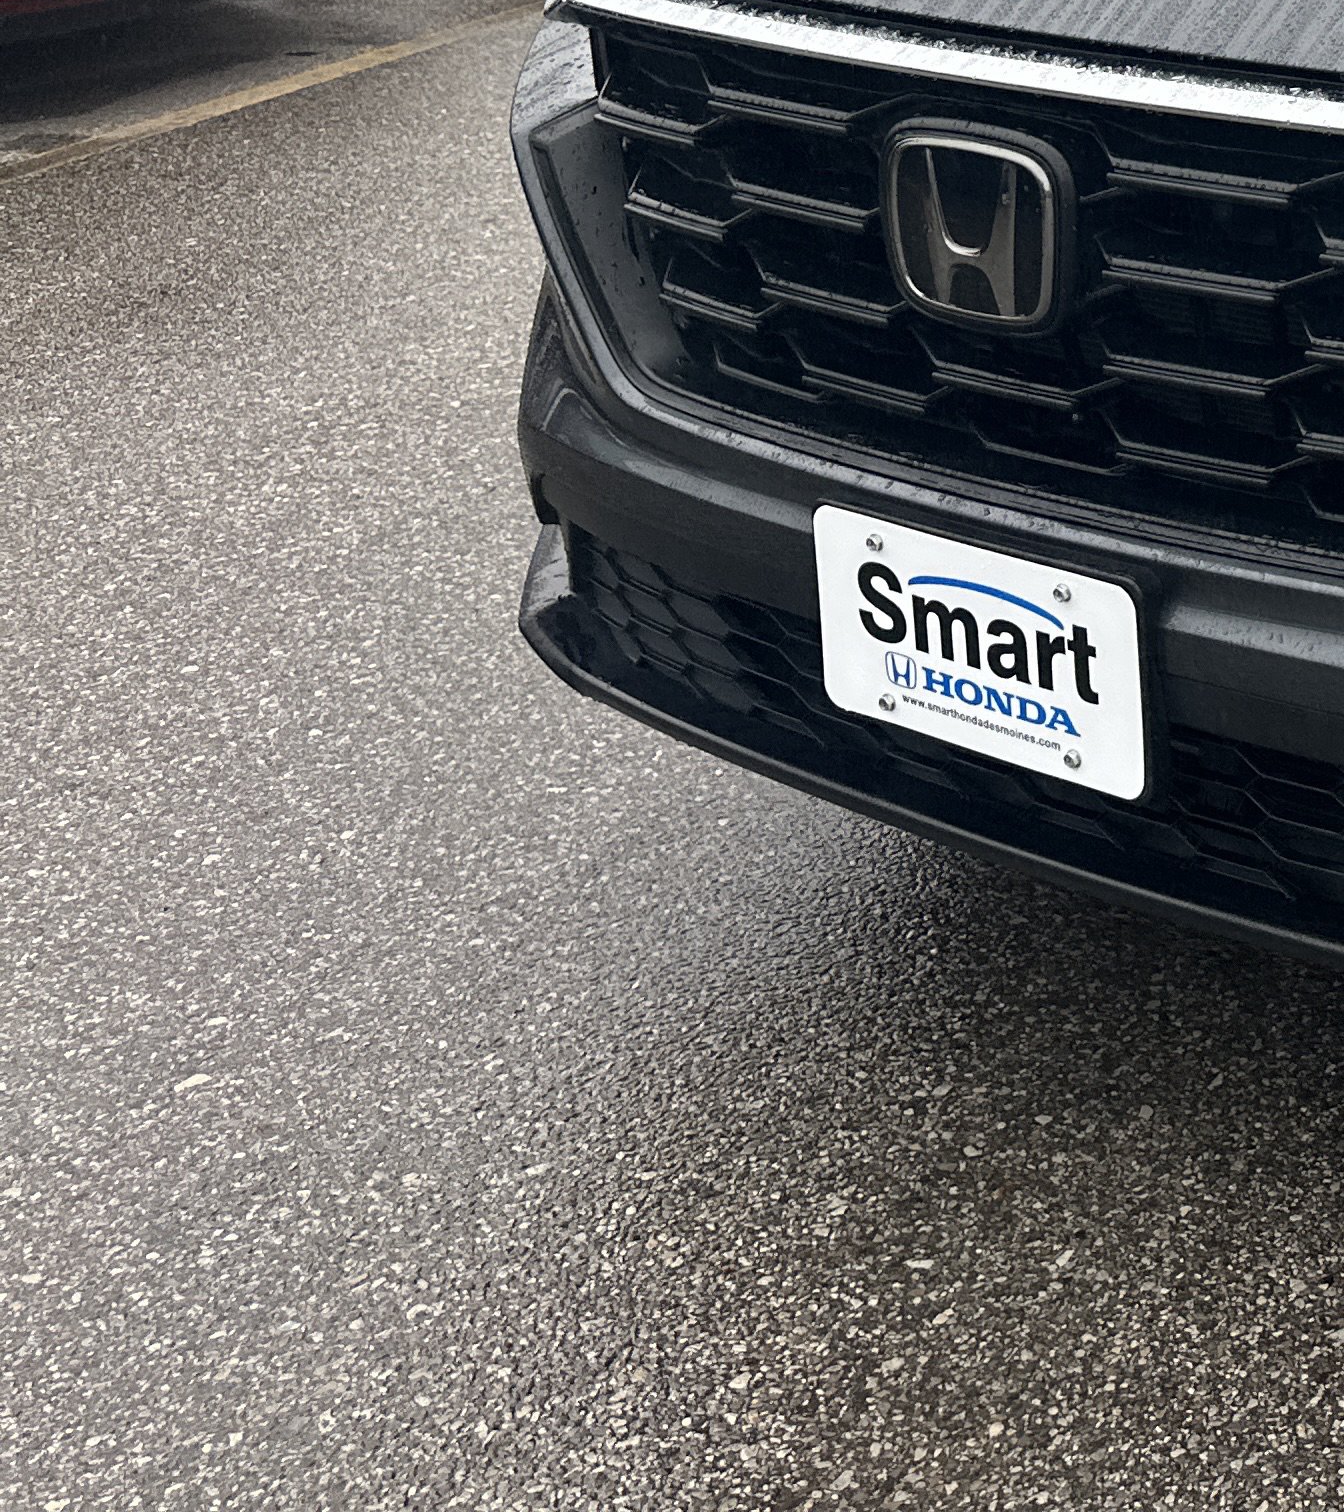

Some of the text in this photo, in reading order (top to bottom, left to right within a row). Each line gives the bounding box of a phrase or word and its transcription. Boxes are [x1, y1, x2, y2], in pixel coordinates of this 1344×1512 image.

[857, 561, 1100, 706] Smart
[901, 694, 1062, 752] www.smarthondadesmoines.com
[921, 666, 1081, 737] HONDA
